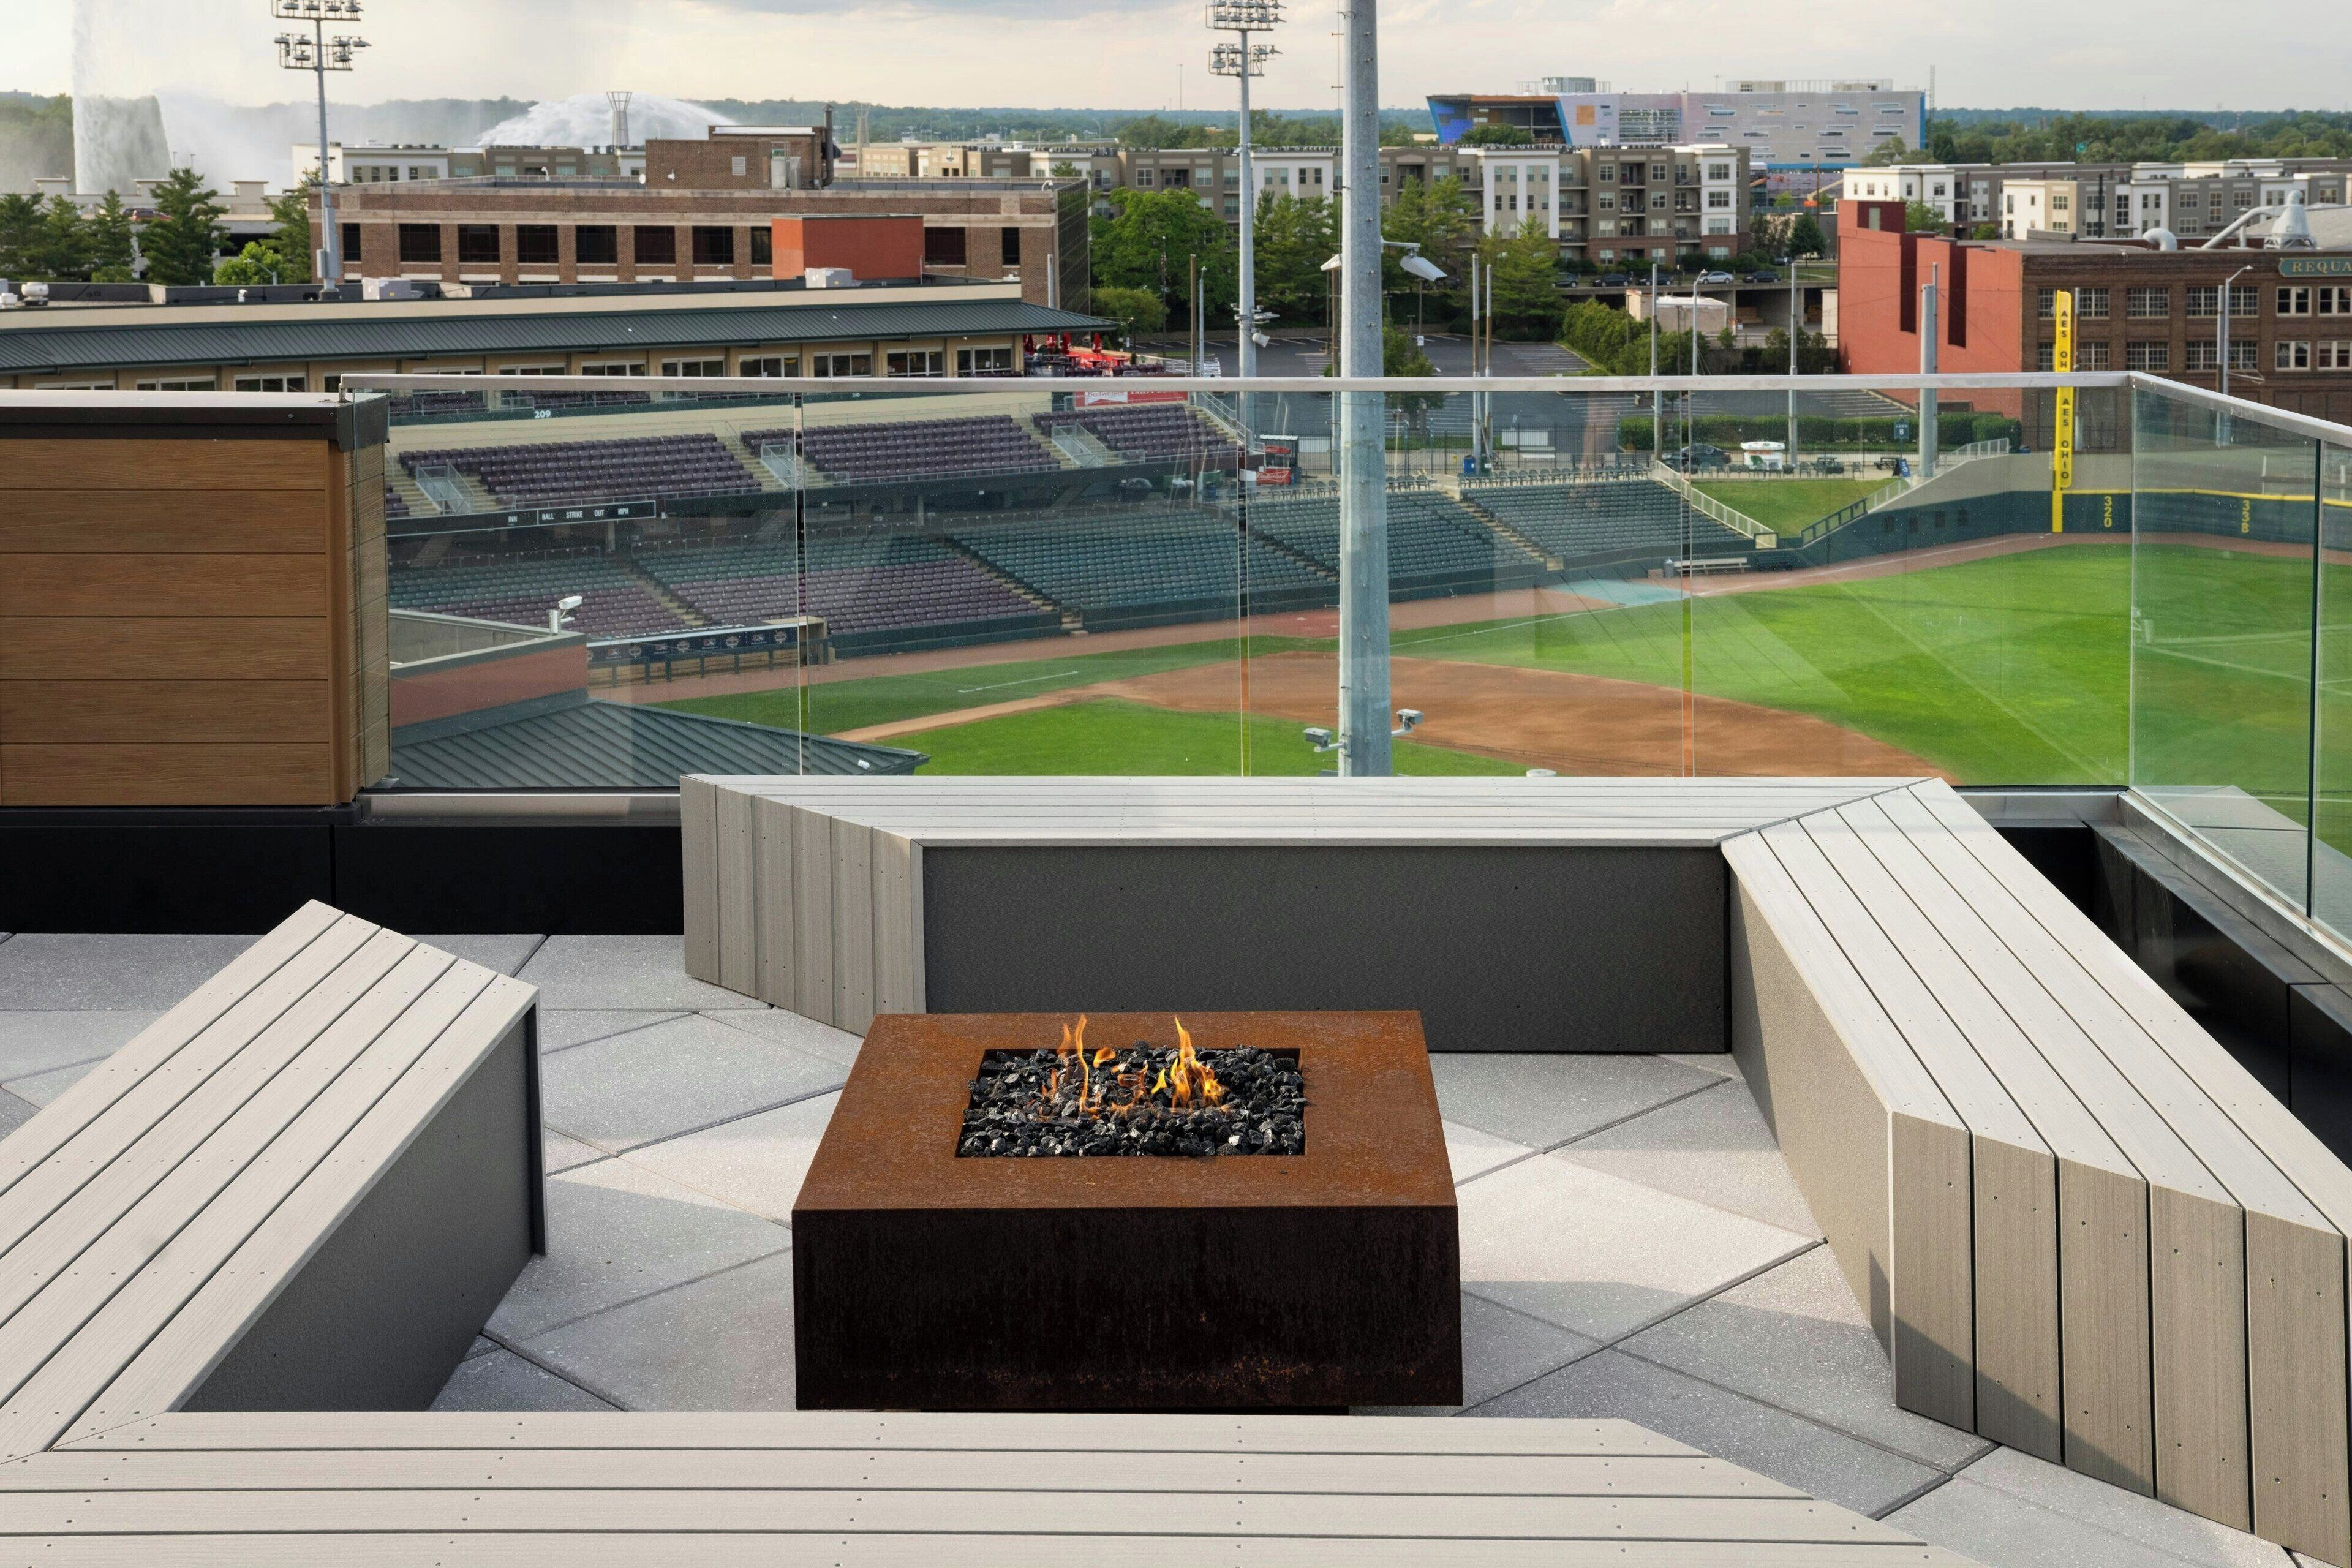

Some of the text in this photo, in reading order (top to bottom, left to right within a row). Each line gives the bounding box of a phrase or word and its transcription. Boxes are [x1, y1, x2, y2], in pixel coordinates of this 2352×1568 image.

[2292, 261, 2352, 274] REQUA
[533, 410, 551, 419] 209
[2060, 440, 2070, 479] OHIO
[2103, 496, 2112, 527] 320
[2241, 499, 2250, 533] 338
